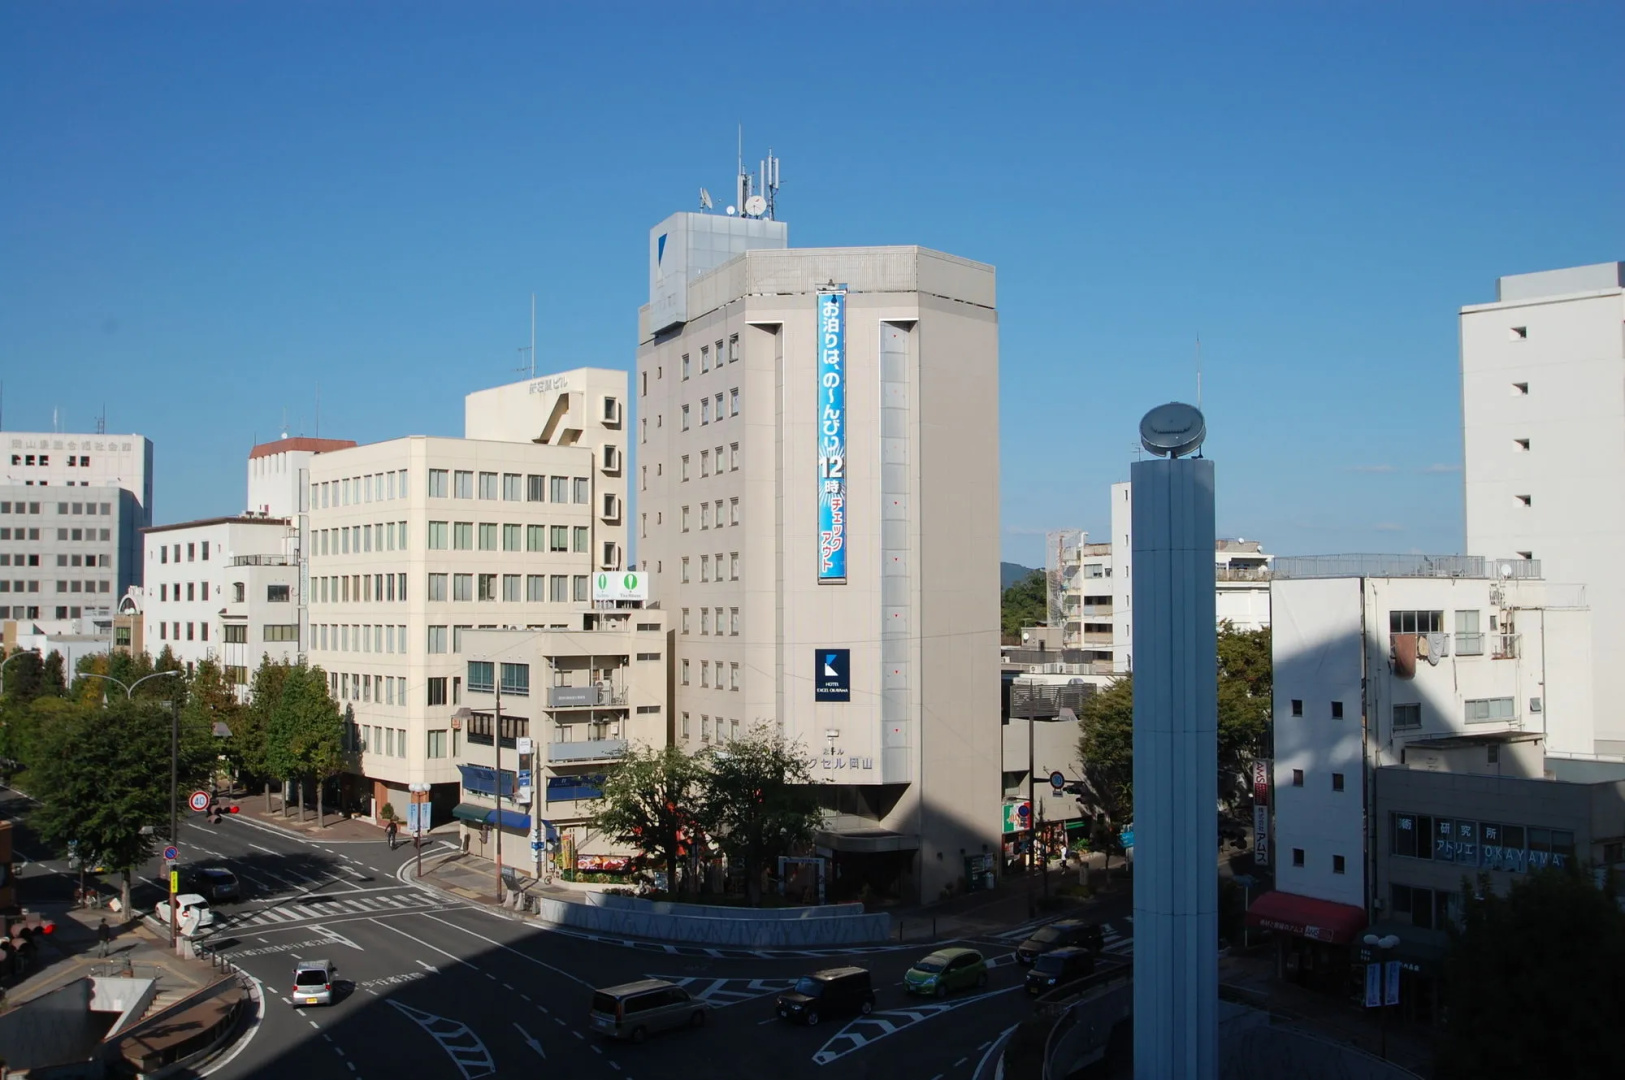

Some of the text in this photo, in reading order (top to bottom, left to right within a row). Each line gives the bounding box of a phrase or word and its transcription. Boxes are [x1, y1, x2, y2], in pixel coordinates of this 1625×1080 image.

[797, 758, 873, 769] クセル岡山
[1256, 762, 1265, 783] AMS
[194, 796, 205, 806] 40
[1437, 840, 1560, 865] アトリエ OKAYAMA
